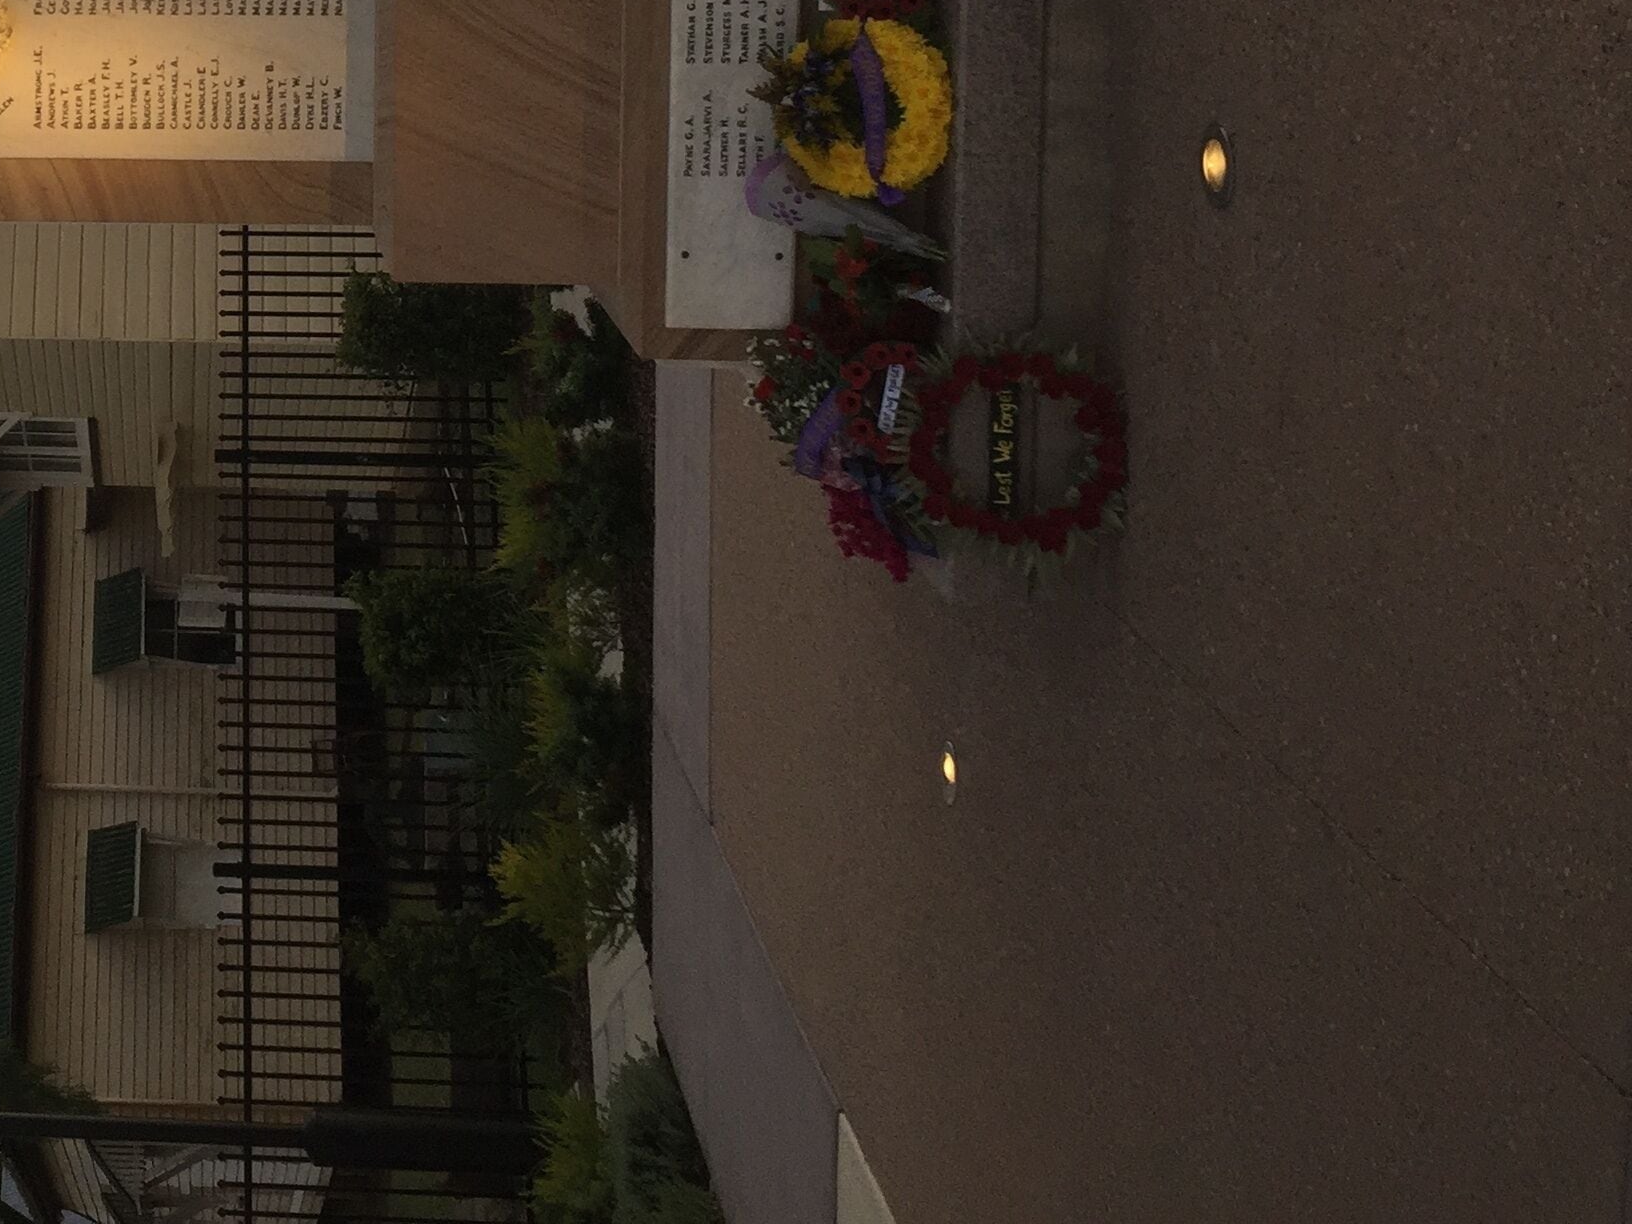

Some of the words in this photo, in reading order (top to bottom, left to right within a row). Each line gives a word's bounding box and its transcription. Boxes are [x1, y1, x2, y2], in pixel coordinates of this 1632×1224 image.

[704, 2, 715, 64] STEVENSON
[739, 23, 750, 64] TANNER
[47, 83, 55, 129] ANDREWS
[61, 100, 69, 129] ATKIN
[74, 95, 83, 129] BAKER
[88, 89, 96, 129] BAXTER
[102, 85, 110, 129] BEASLEY
[115, 105, 123, 129] BELL
[129, 72, 137, 129] BOTTOMLEY
[143, 90, 151, 129] BUDDEN
[156, 84, 165, 129] BULLOCK
[170, 72, 178, 129] CARMICHAEL
[183, 93, 191, 129] CASTLE
[197, 79, 205, 129] CHANDLER
[211, 82, 219, 129] CONNELLY
[224, 91, 232, 129] CROUCH
[237, 92, 246, 130] DAHLER
[251, 104, 259, 130] DEAN
[265, 78, 273, 130] DEVANNEY
[279, 103, 287, 130] DAVIS
[333, 103, 342, 130] FINCH
[684, 145, 694, 177] PAYNE
[993, 440, 1013, 463] We
[993, 472, 1012, 505] Lest
